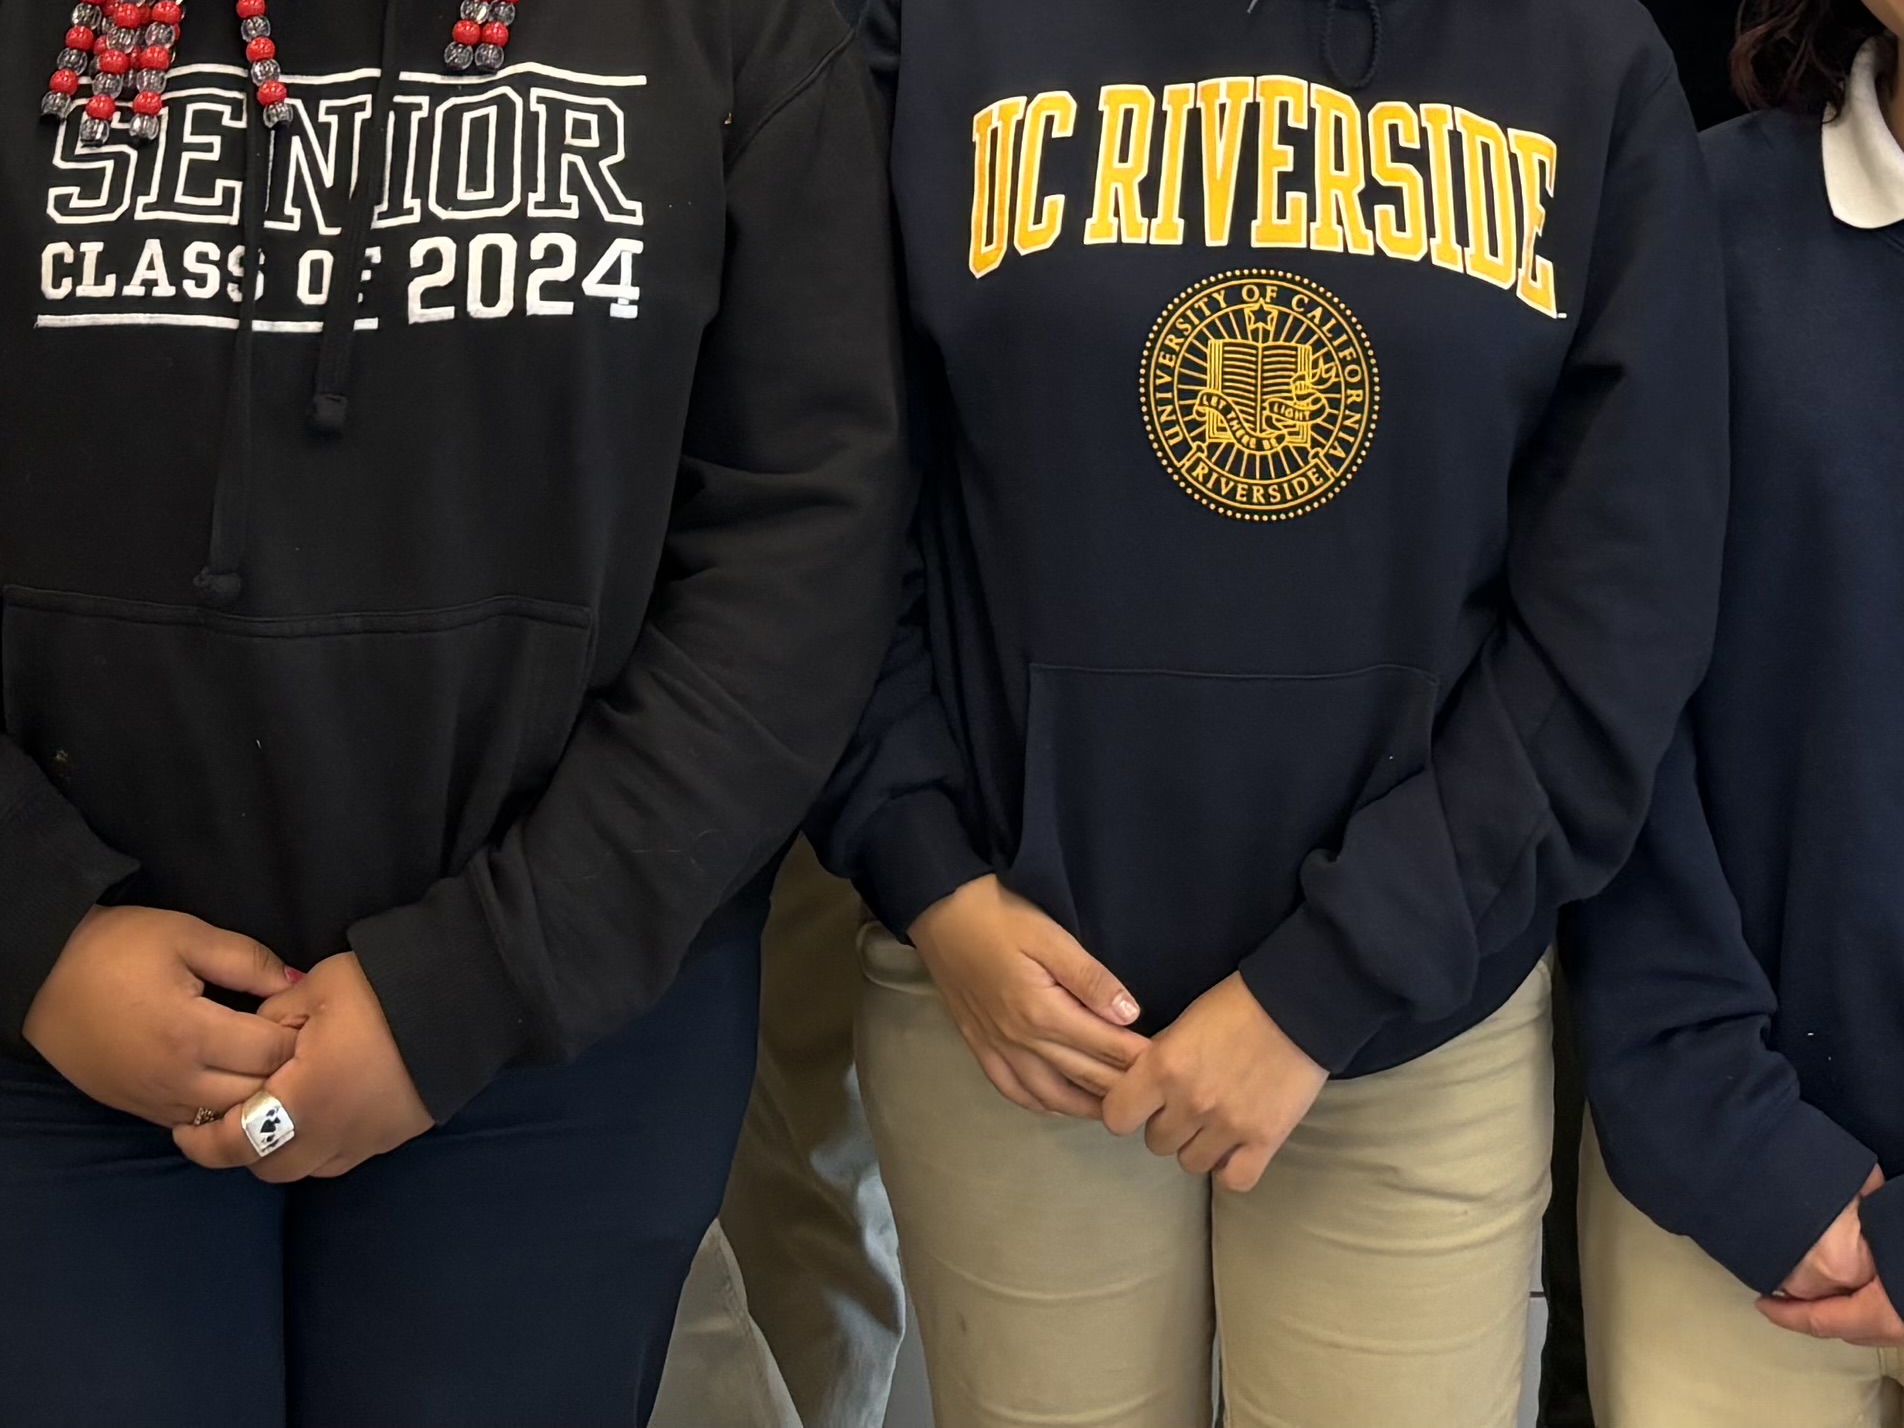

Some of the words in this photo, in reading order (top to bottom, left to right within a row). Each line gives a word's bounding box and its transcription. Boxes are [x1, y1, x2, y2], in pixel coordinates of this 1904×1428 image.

[46, 85, 645, 236] SENIOR
[967, 89, 1077, 280] UC
[1083, 74, 1558, 318] RIVERSIDE
[41, 239, 266, 302] CLASS
[407, 232, 645, 324] 2024
[1155, 289, 1228, 446] UNIVERSITY
[1241, 284, 1278, 302] OF
[1291, 294, 1365, 459] CALIFORNIA
[1203, 394, 1226, 410] LET
[1274, 403, 1310, 420] LIGHT
[1192, 464, 1324, 504] RIVERSIDE
